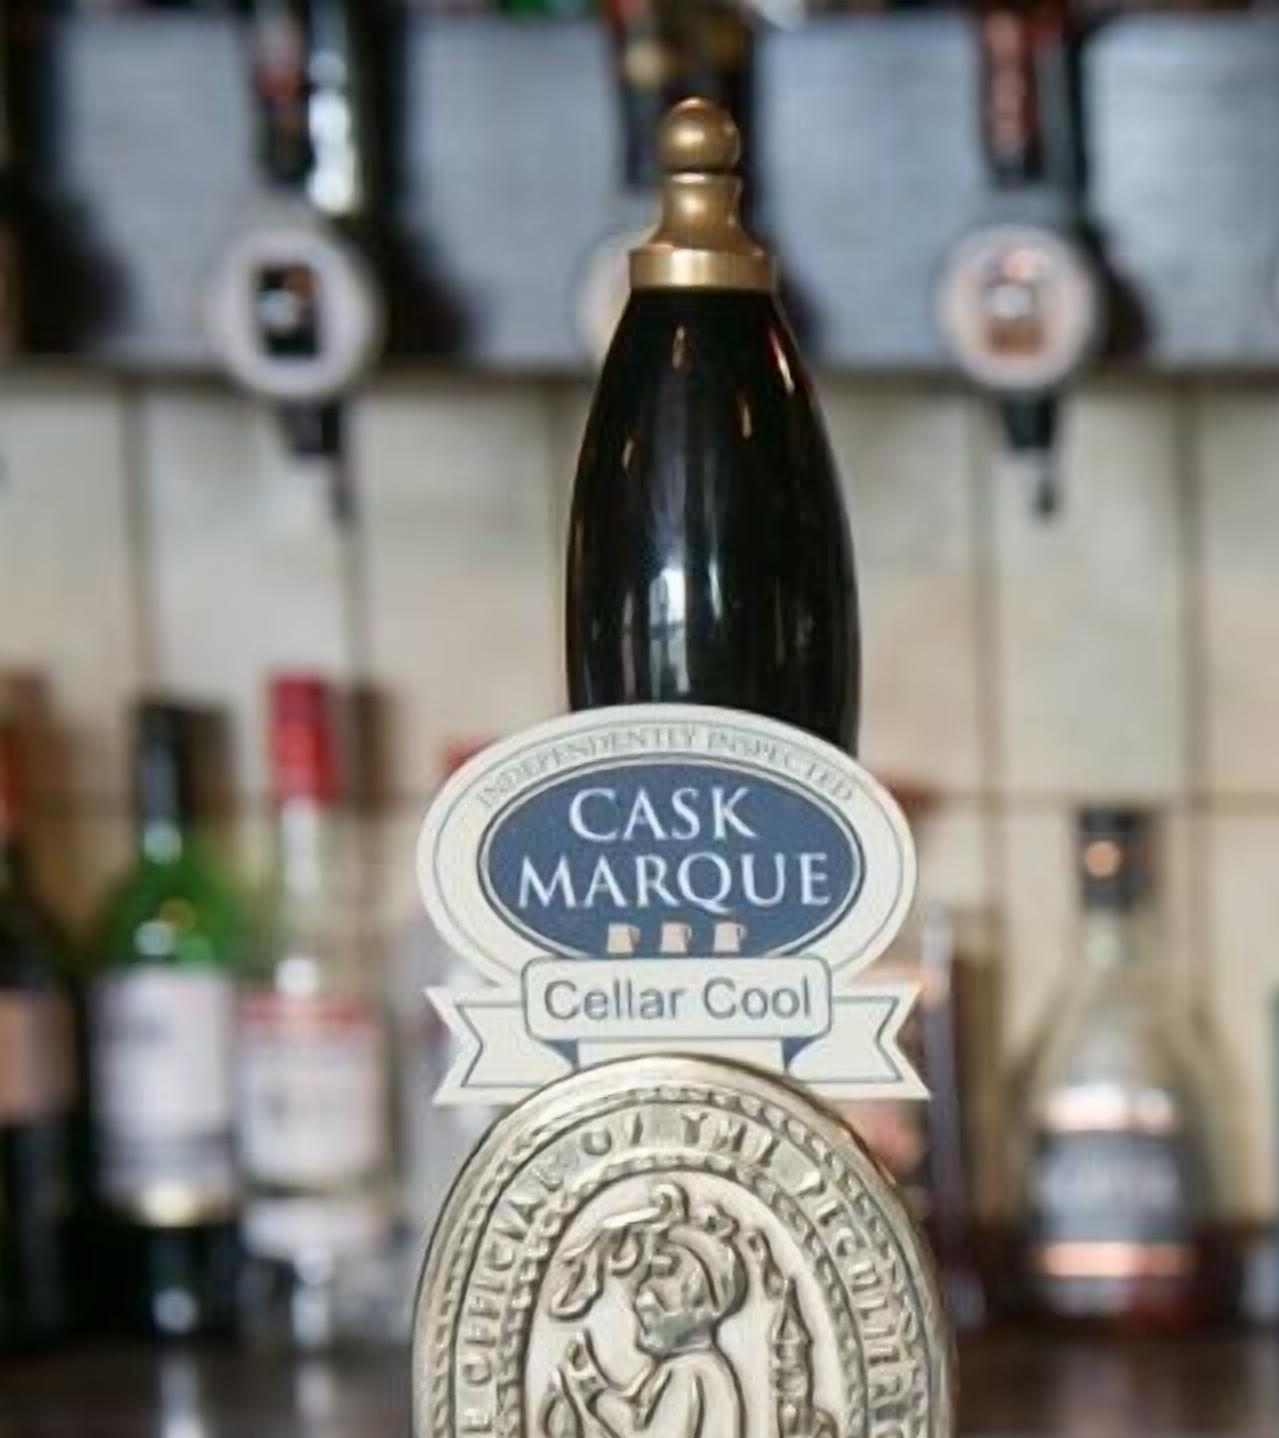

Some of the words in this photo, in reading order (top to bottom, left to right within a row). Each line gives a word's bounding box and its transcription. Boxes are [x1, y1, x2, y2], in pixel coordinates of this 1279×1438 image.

[475, 722, 698, 810] INDEPENDENTLY
[567, 786, 758, 842] CASK
[516, 851, 832, 916] MARQUE
[543, 977, 684, 1023] Cellar
[701, 976, 811, 1020] Cool
